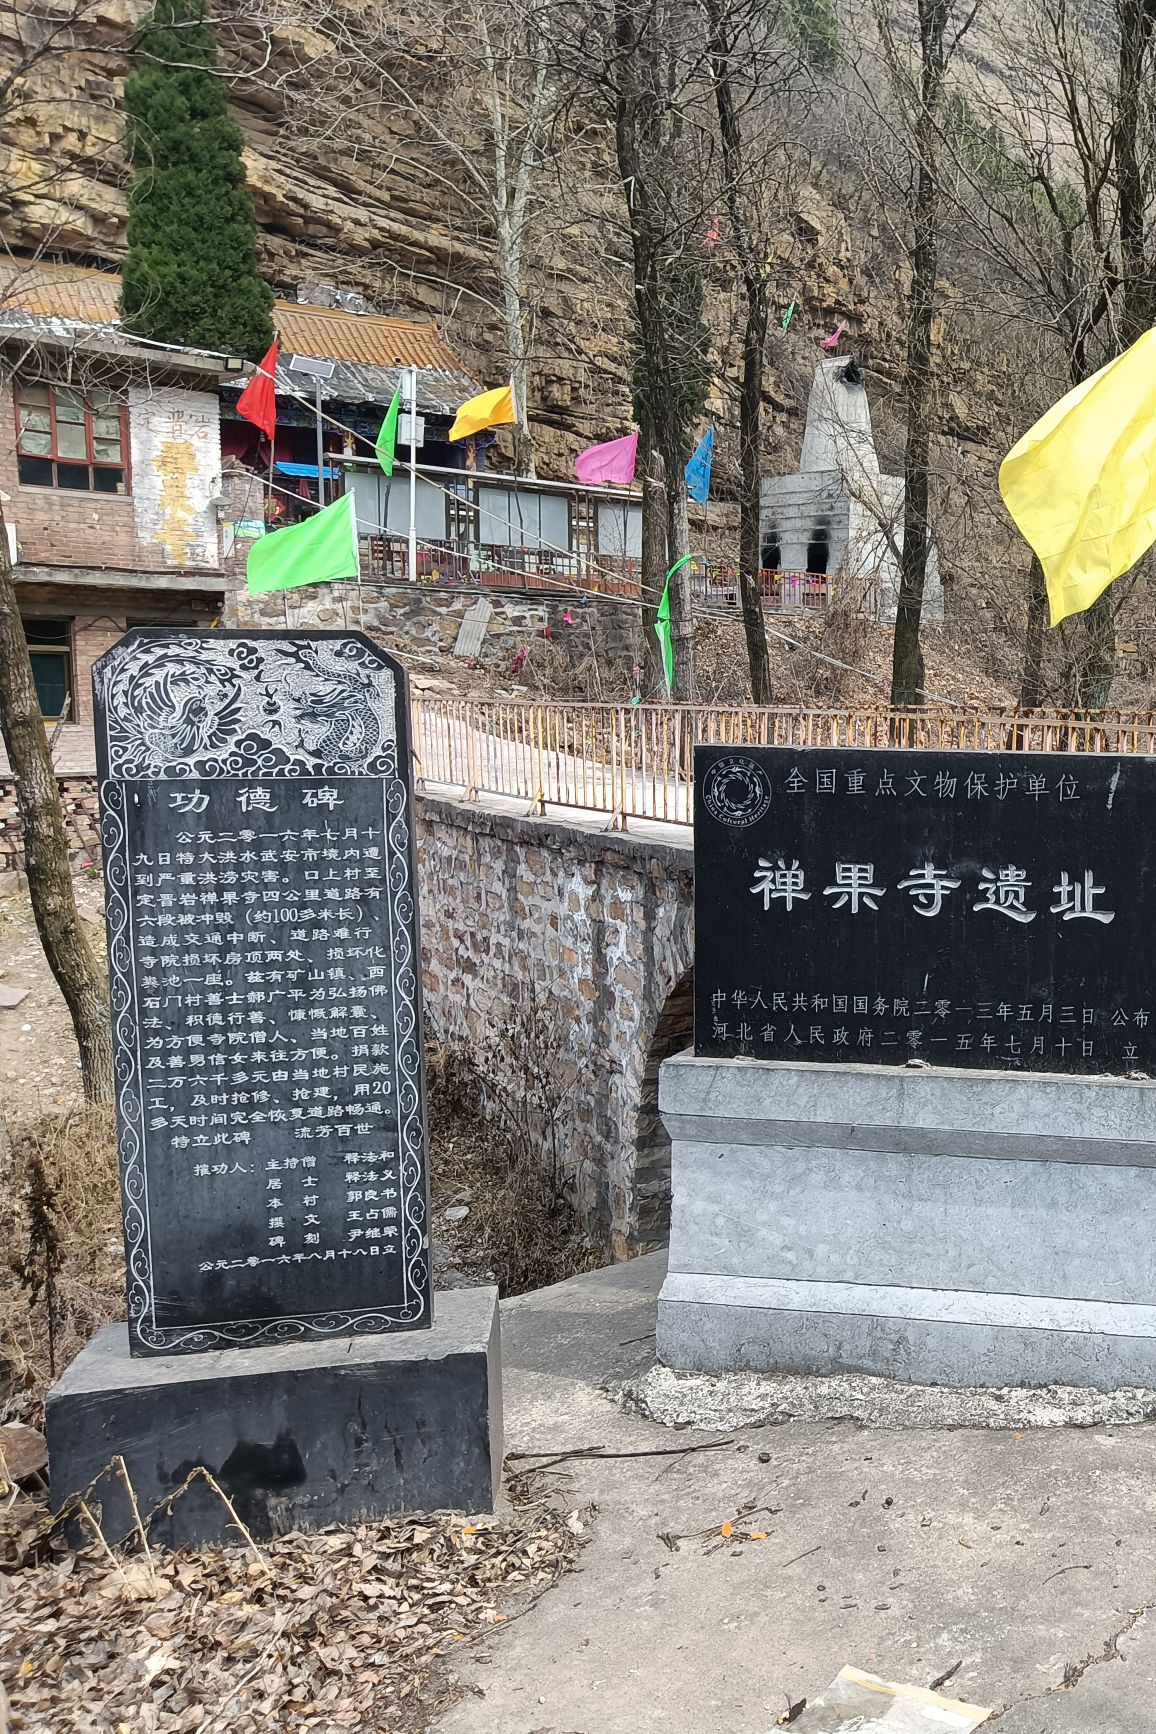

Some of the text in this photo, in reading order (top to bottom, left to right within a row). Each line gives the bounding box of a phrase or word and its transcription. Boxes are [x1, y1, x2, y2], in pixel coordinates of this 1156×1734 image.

[783, 766, 1082, 802] 全国重点文物保护单位
[169, 786, 344, 813] 功德碑
[705, 794, 770, 826] China Cultural Heritage
[175, 828, 381, 845] 公元二零一六年七月十
[132, 846, 383, 867] 九日特大洪水武安市境内遭
[135, 886, 384, 909] 定晋岩禅果寺四公里道路有
[750, 857, 1116, 925] 禅果寺遗址
[142, 985, 389, 1009] 石门村善士郝广平为弘扬佛
[712, 988, 1094, 1024] 中华人民共和国国务院二零一三年五月三日
[712, 1022, 1140, 1060] 河北省人民政府二零一五年七月十日 立
[147, 1063, 391, 1089] 二万六千多元由当地村民施
[171, 1121, 374, 1149] 特立此碑 流芳百世
[265, 1155, 317, 1171] 主持僧
[343, 1150, 395, 1166] 释法和
[344, 1169, 397, 1184] 释法义
[346, 1187, 397, 1204] 郭良书
[346, 1206, 398, 1223] 王占儒
[198, 1244, 397, 1273] 公元二零一六年八月十八日立
